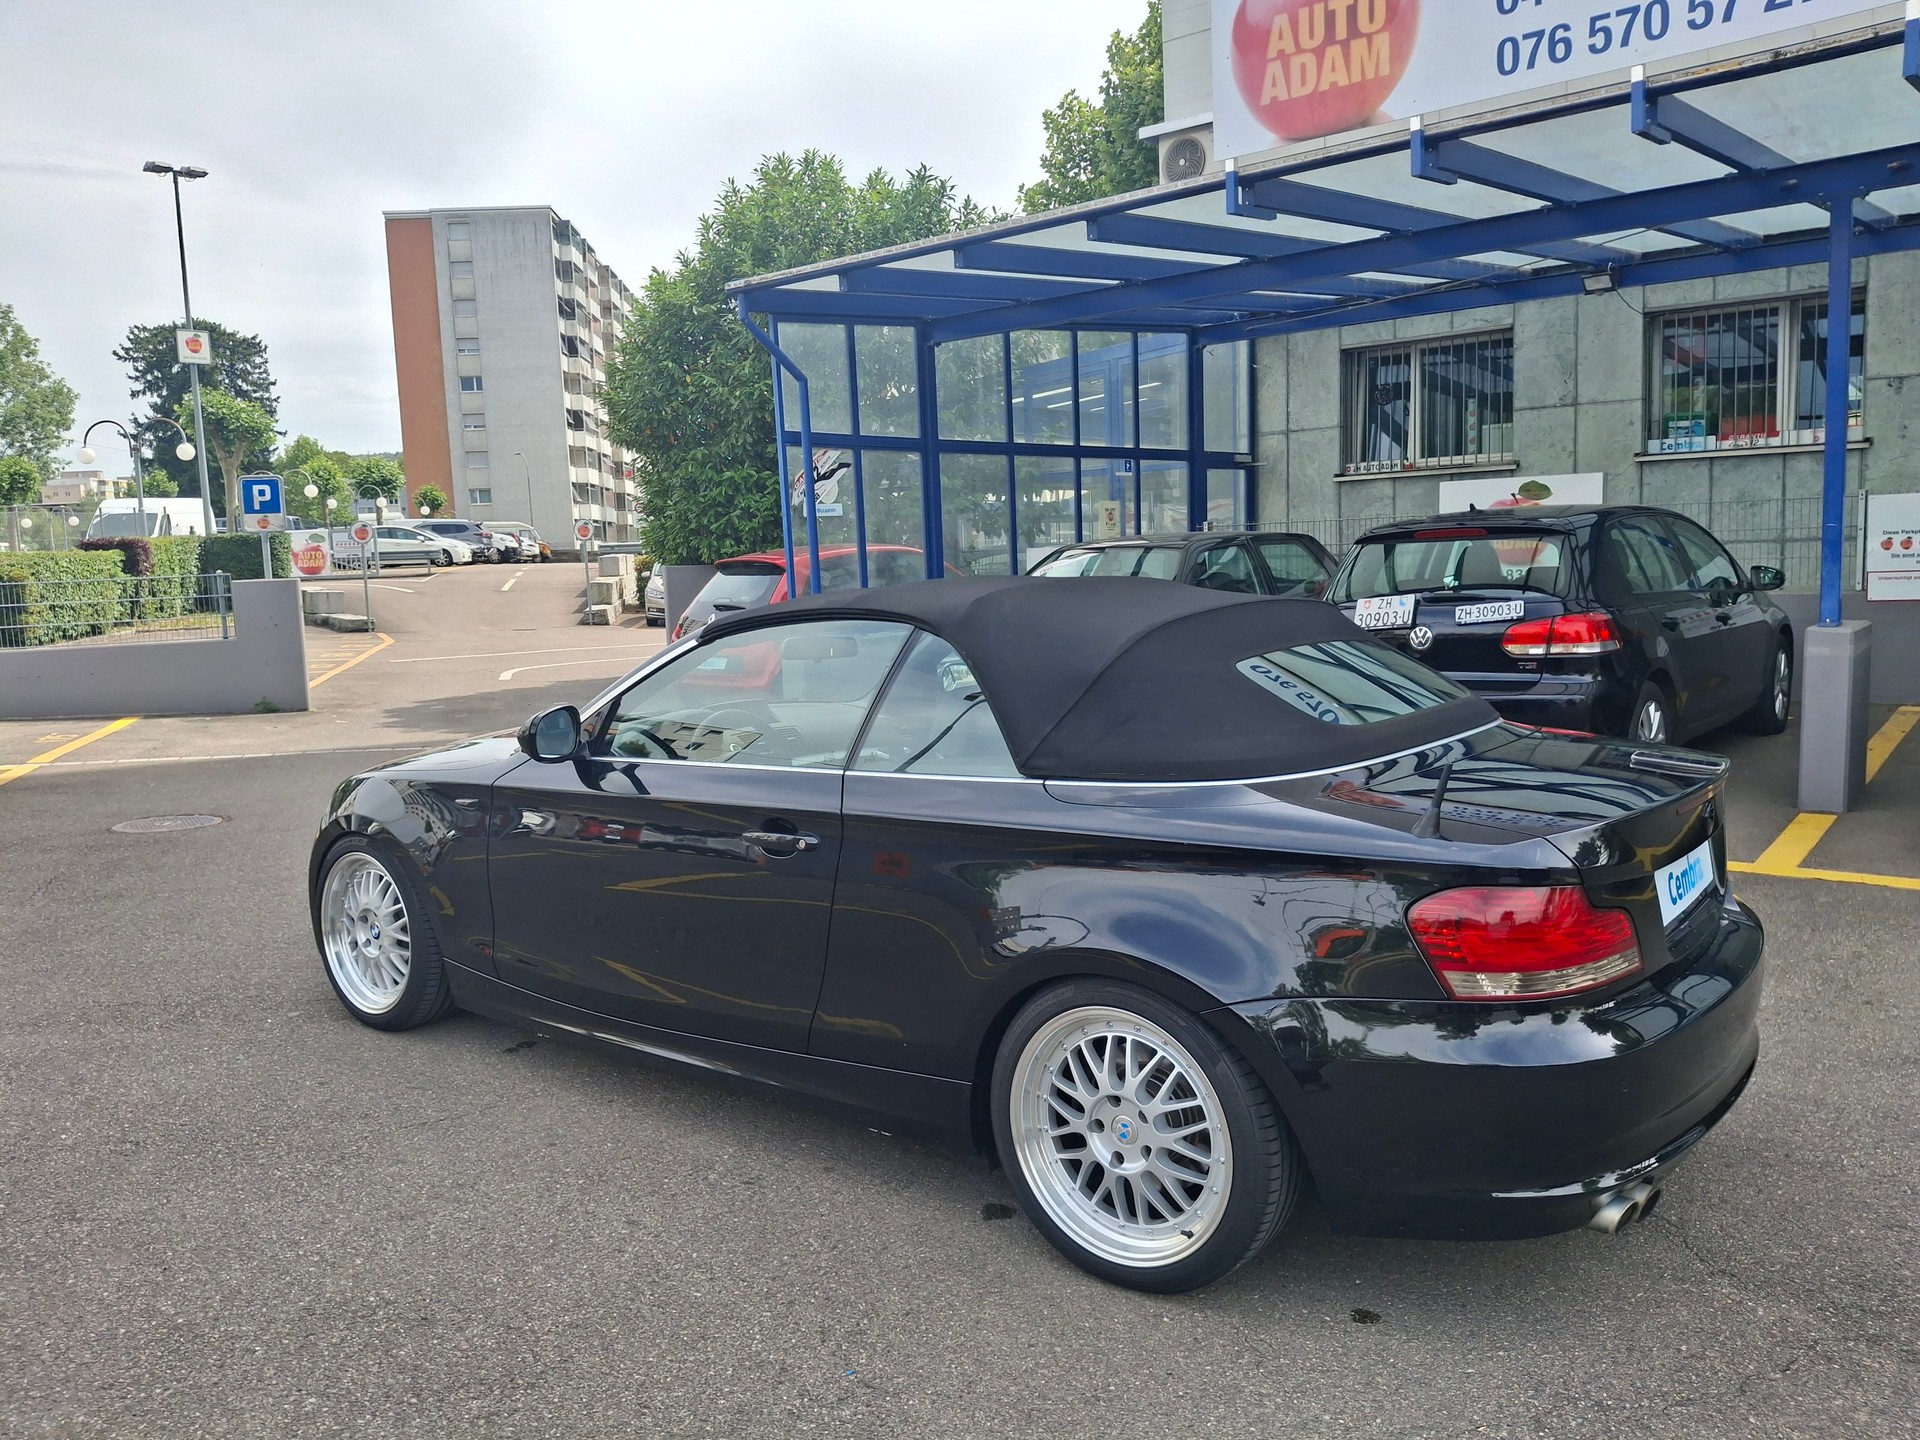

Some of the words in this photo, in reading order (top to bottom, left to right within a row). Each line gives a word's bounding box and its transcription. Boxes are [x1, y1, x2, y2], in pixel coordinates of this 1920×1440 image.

[1266, 0, 1387, 59] AUTO
[1496, 22, 1573, 77] 076
[1587, 0, 1670, 55] 570
[1259, 31, 1391, 106] ADAM
[252, 484, 272, 511] P
[297, 559, 324, 568] ADAM
[298, 551, 323, 559] AUTO
[1378, 598, 1392, 610] ZH
[1668, 855, 1705, 906] Cembra
